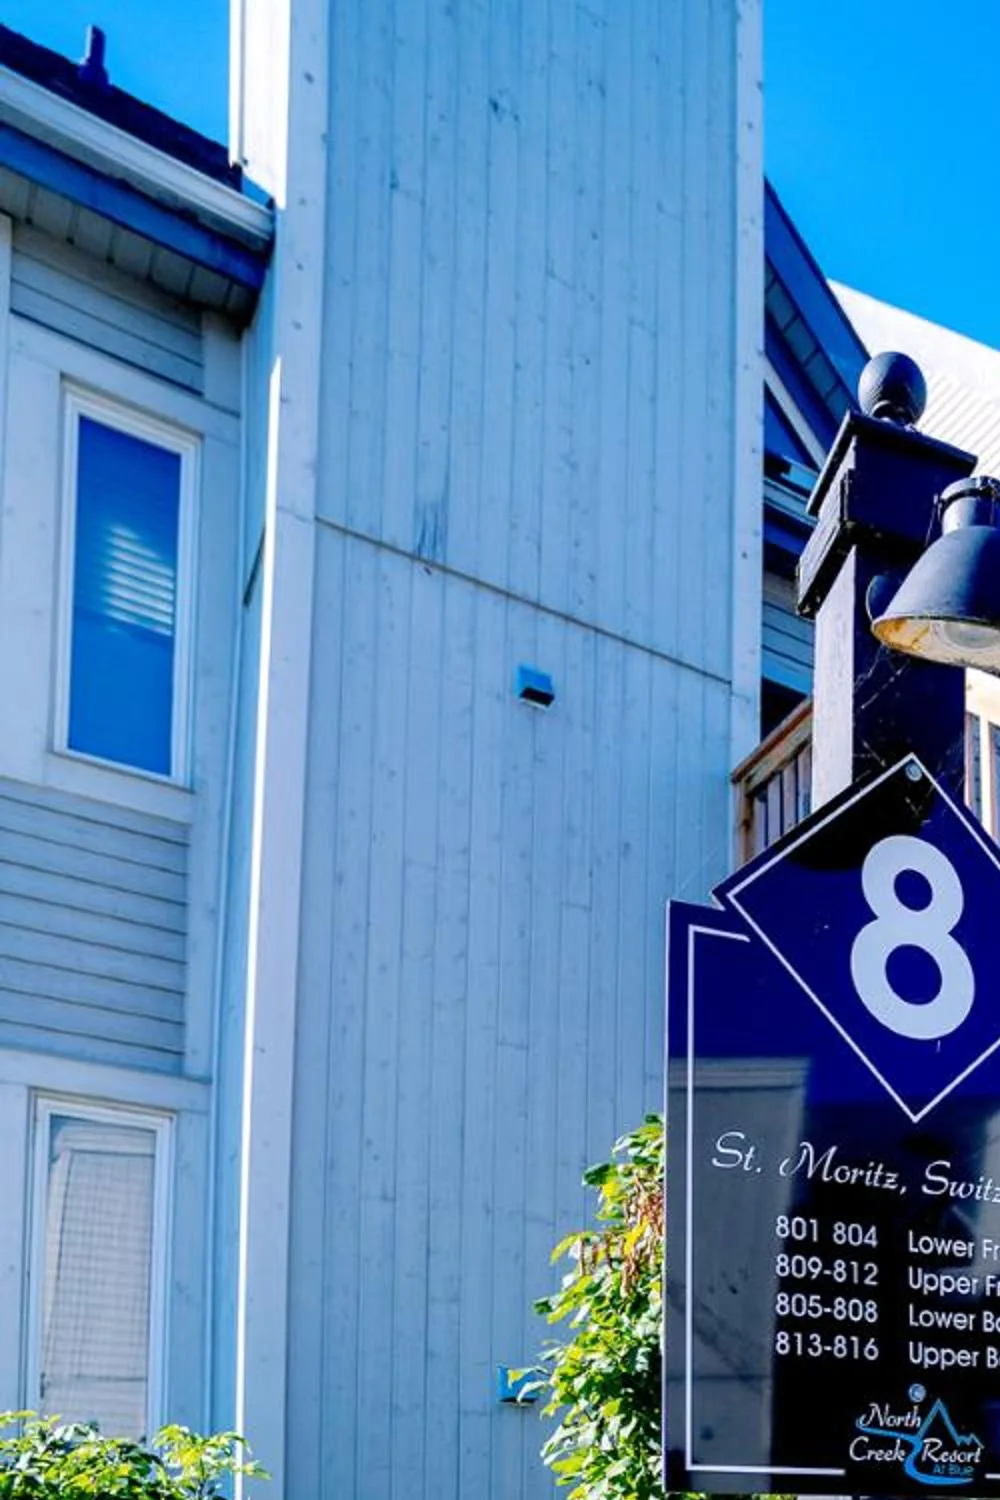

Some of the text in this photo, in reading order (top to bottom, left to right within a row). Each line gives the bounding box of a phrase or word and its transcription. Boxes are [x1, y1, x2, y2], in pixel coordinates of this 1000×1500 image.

[850, 834, 976, 1040] 8
[711, 1131, 762, 1174] St.
[779, 1141, 907, 1196] Moritz,
[775, 1215, 819, 1243] 801
[832, 1221, 878, 1248] 804
[908, 1229, 975, 1258] Lower
[775, 1253, 879, 1286] 809-812
[908, 1266, 980, 1296] Upper
[775, 1292, 878, 1323] 805-808
[908, 1303, 976, 1332] Lower
[775, 1331, 880, 1361] 813-816
[908, 1341, 980, 1370] Upper
[858, 1402, 922, 1428] North
[849, 1435, 982, 1463] Creek Resort
